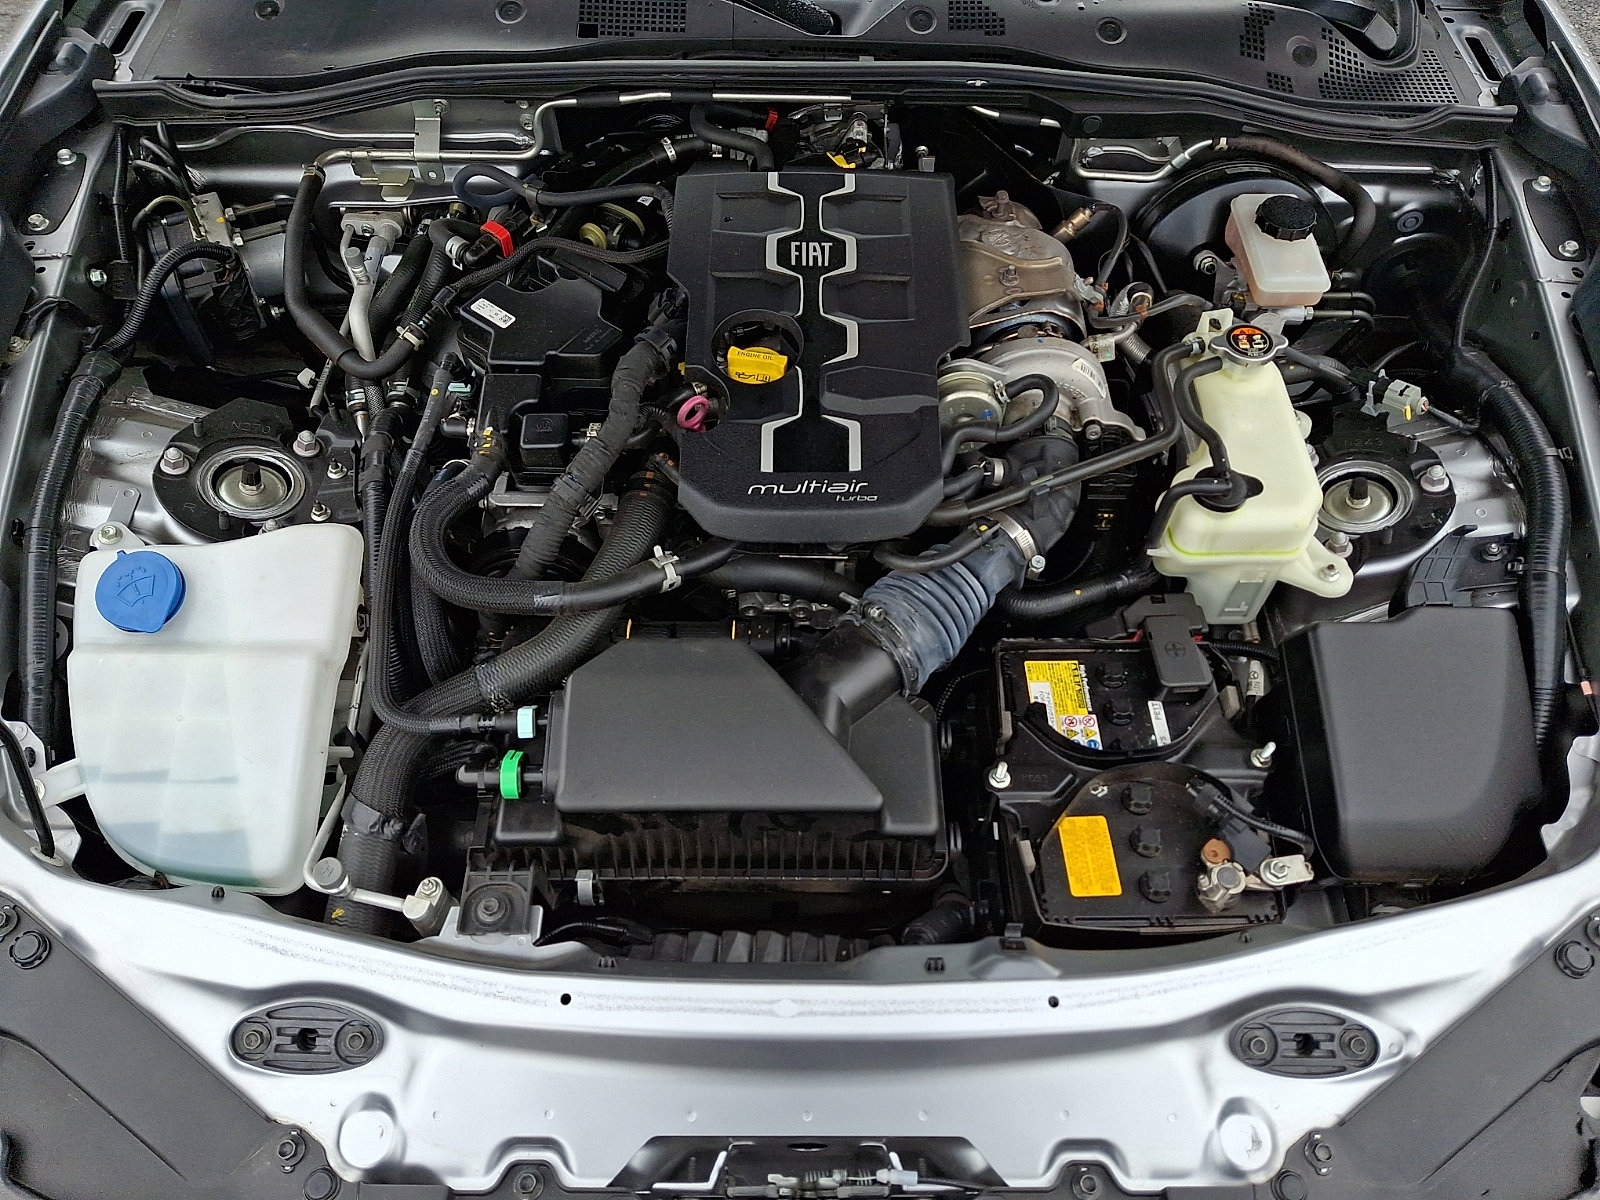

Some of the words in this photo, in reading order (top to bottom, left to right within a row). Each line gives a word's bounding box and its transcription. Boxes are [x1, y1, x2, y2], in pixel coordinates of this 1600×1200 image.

[790, 241, 833, 267] FIAT
[737, 351, 761, 359] ENGINE
[747, 479, 868, 495] multiair
[836, 494, 878, 502] turbo
[1079, 664, 1087, 677] High
[1082, 677, 1093, 712] Performance
